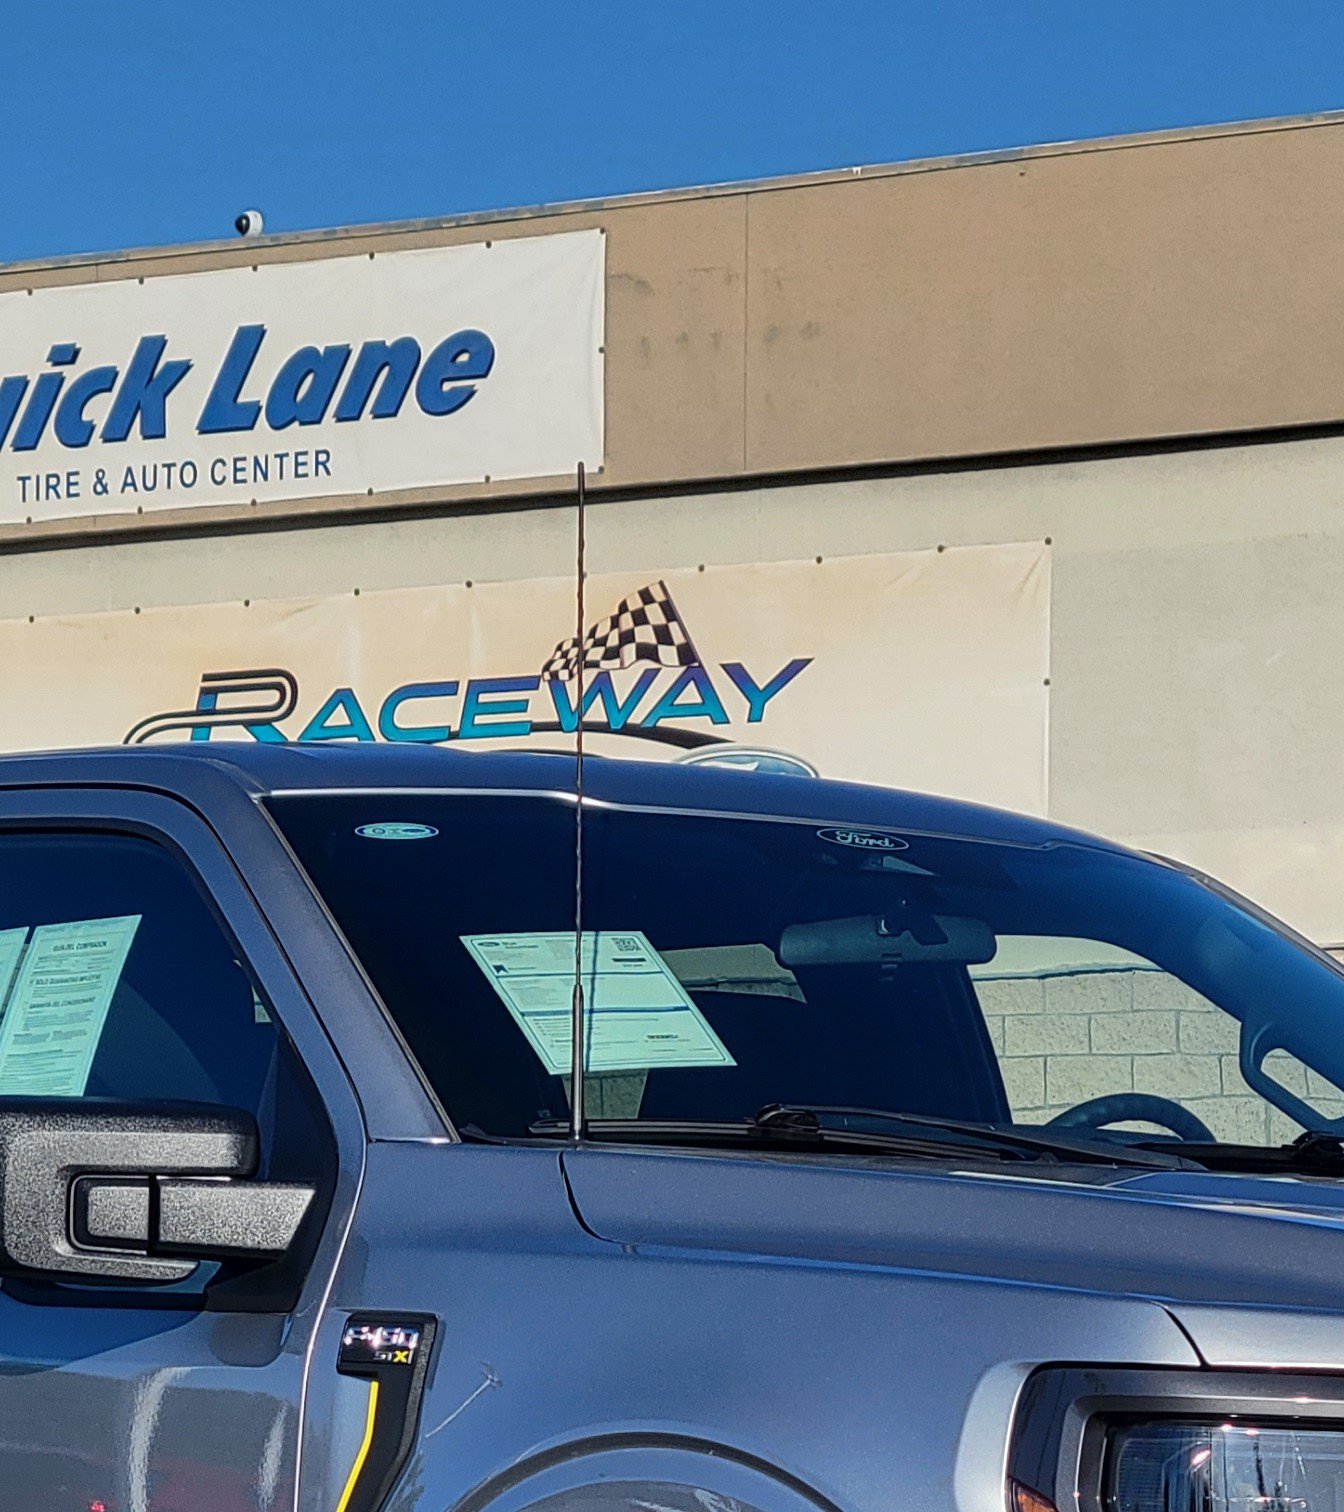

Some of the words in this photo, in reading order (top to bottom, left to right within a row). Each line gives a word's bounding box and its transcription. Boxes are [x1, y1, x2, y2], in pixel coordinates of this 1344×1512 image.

[196, 324, 495, 435] Lane
[16, 470, 82, 503] TIRE
[92, 468, 110, 497] &
[120, 460, 199, 494] AUTO
[209, 449, 332, 487] CENTER
[131, 656, 816, 746] RACEWAY
[835, 830, 895, 848] Ford
